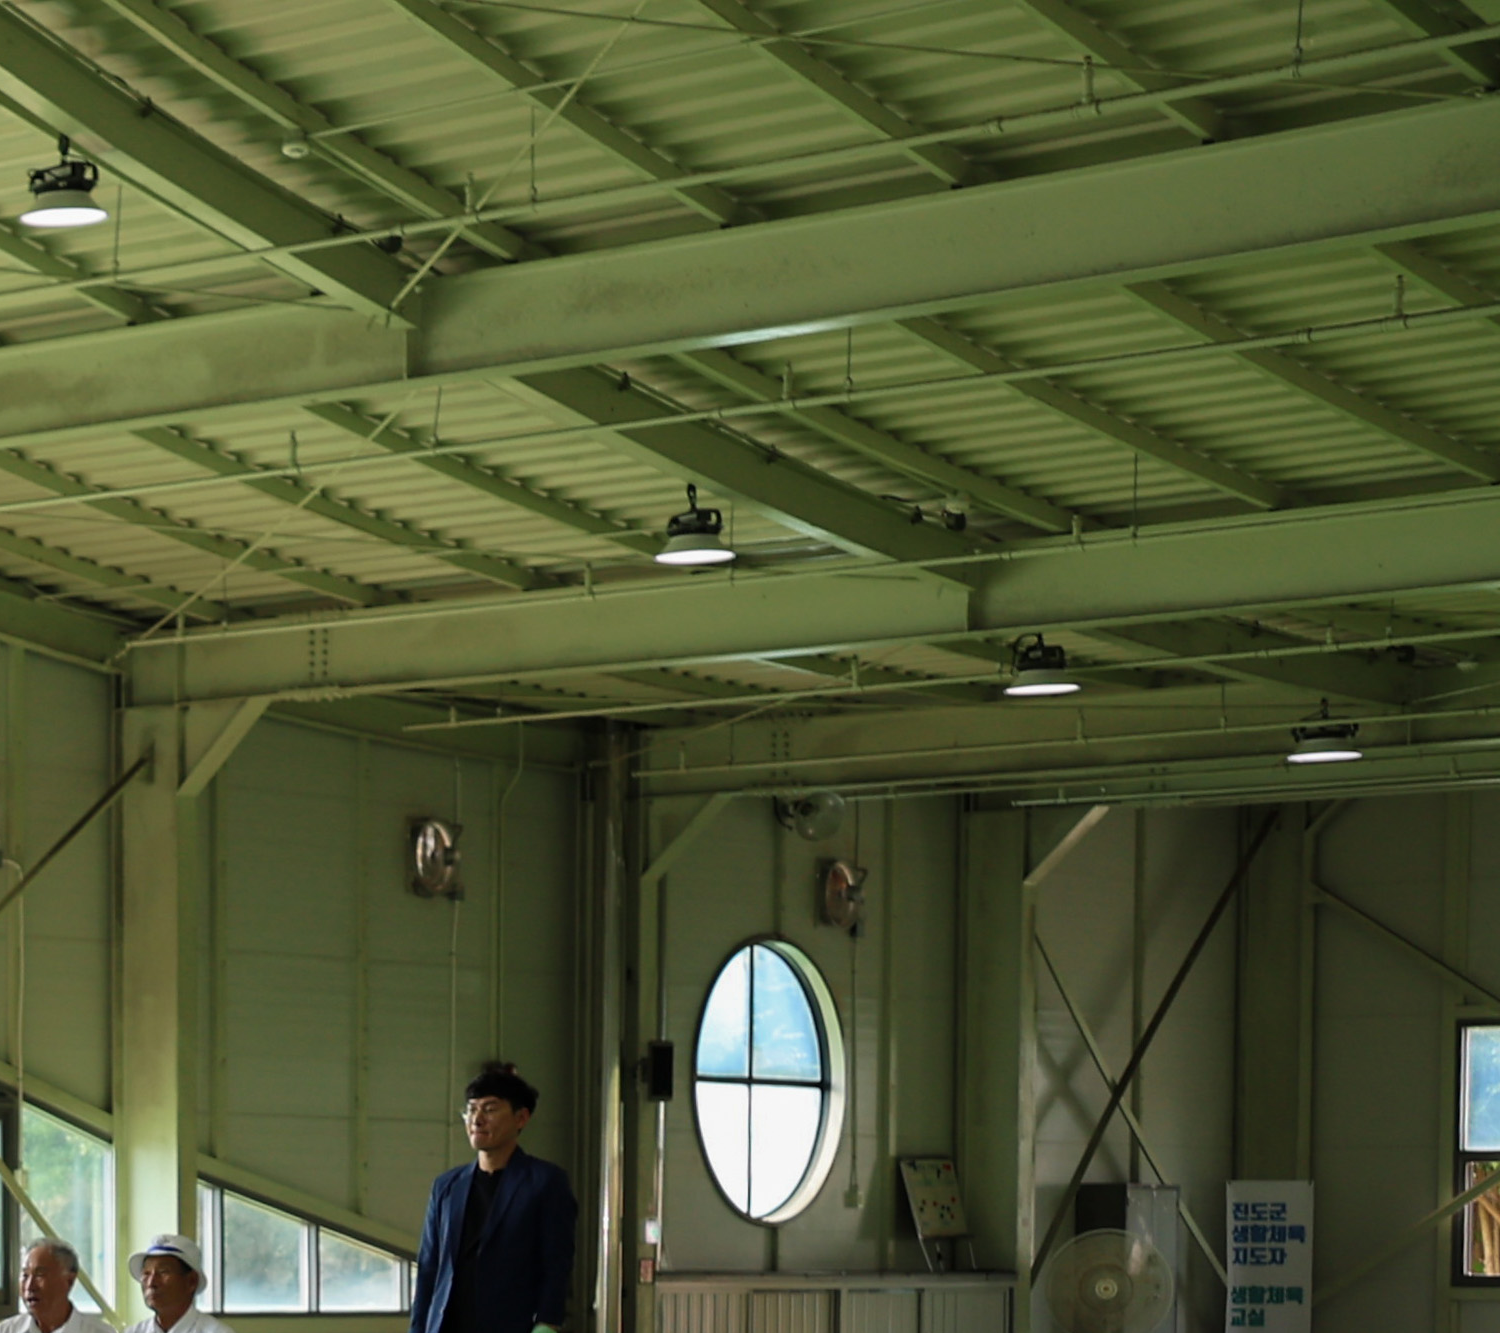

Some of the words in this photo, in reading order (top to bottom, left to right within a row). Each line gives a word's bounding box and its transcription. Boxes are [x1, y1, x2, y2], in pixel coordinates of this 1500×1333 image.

[1231, 1202, 1288, 1222] 진도군
[1231, 1224, 1306, 1244] 생활체육
[1231, 1247, 1288, 1266] 지도자
[1230, 1285, 1304, 1306] 생활체육
[1230, 1308, 1265, 1328] 교실
